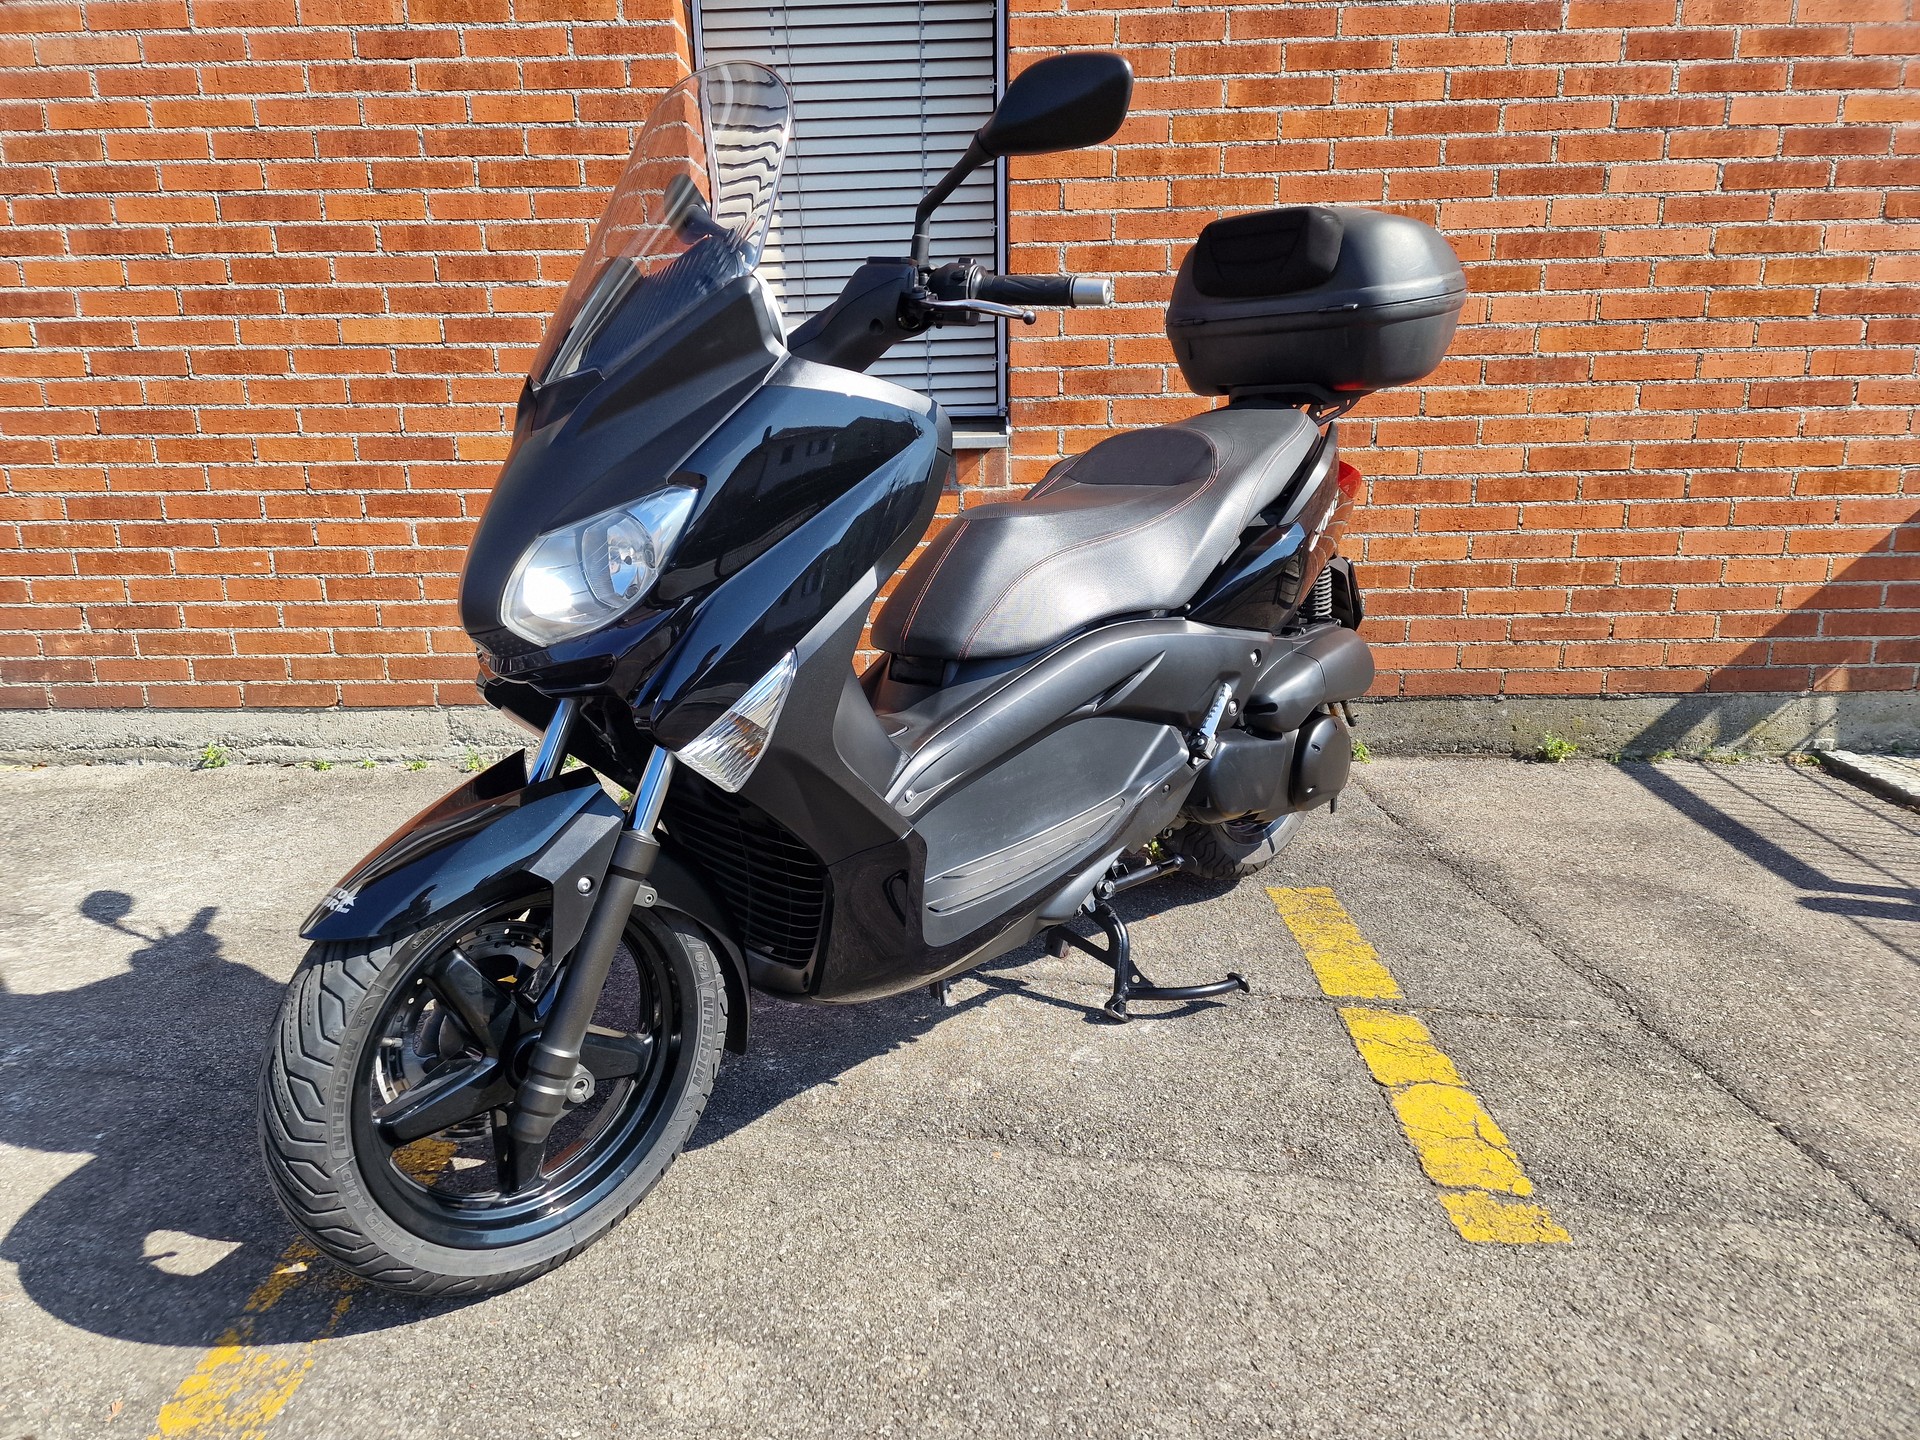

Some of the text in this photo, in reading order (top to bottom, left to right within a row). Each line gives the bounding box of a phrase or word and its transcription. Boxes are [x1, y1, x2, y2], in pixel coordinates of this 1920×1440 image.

[692, 996, 715, 1090] MICHELIN
[332, 1039, 359, 1152] MICHELIN
[340, 1167, 369, 1210] CITY
[365, 1212, 402, 1246] GRIP
